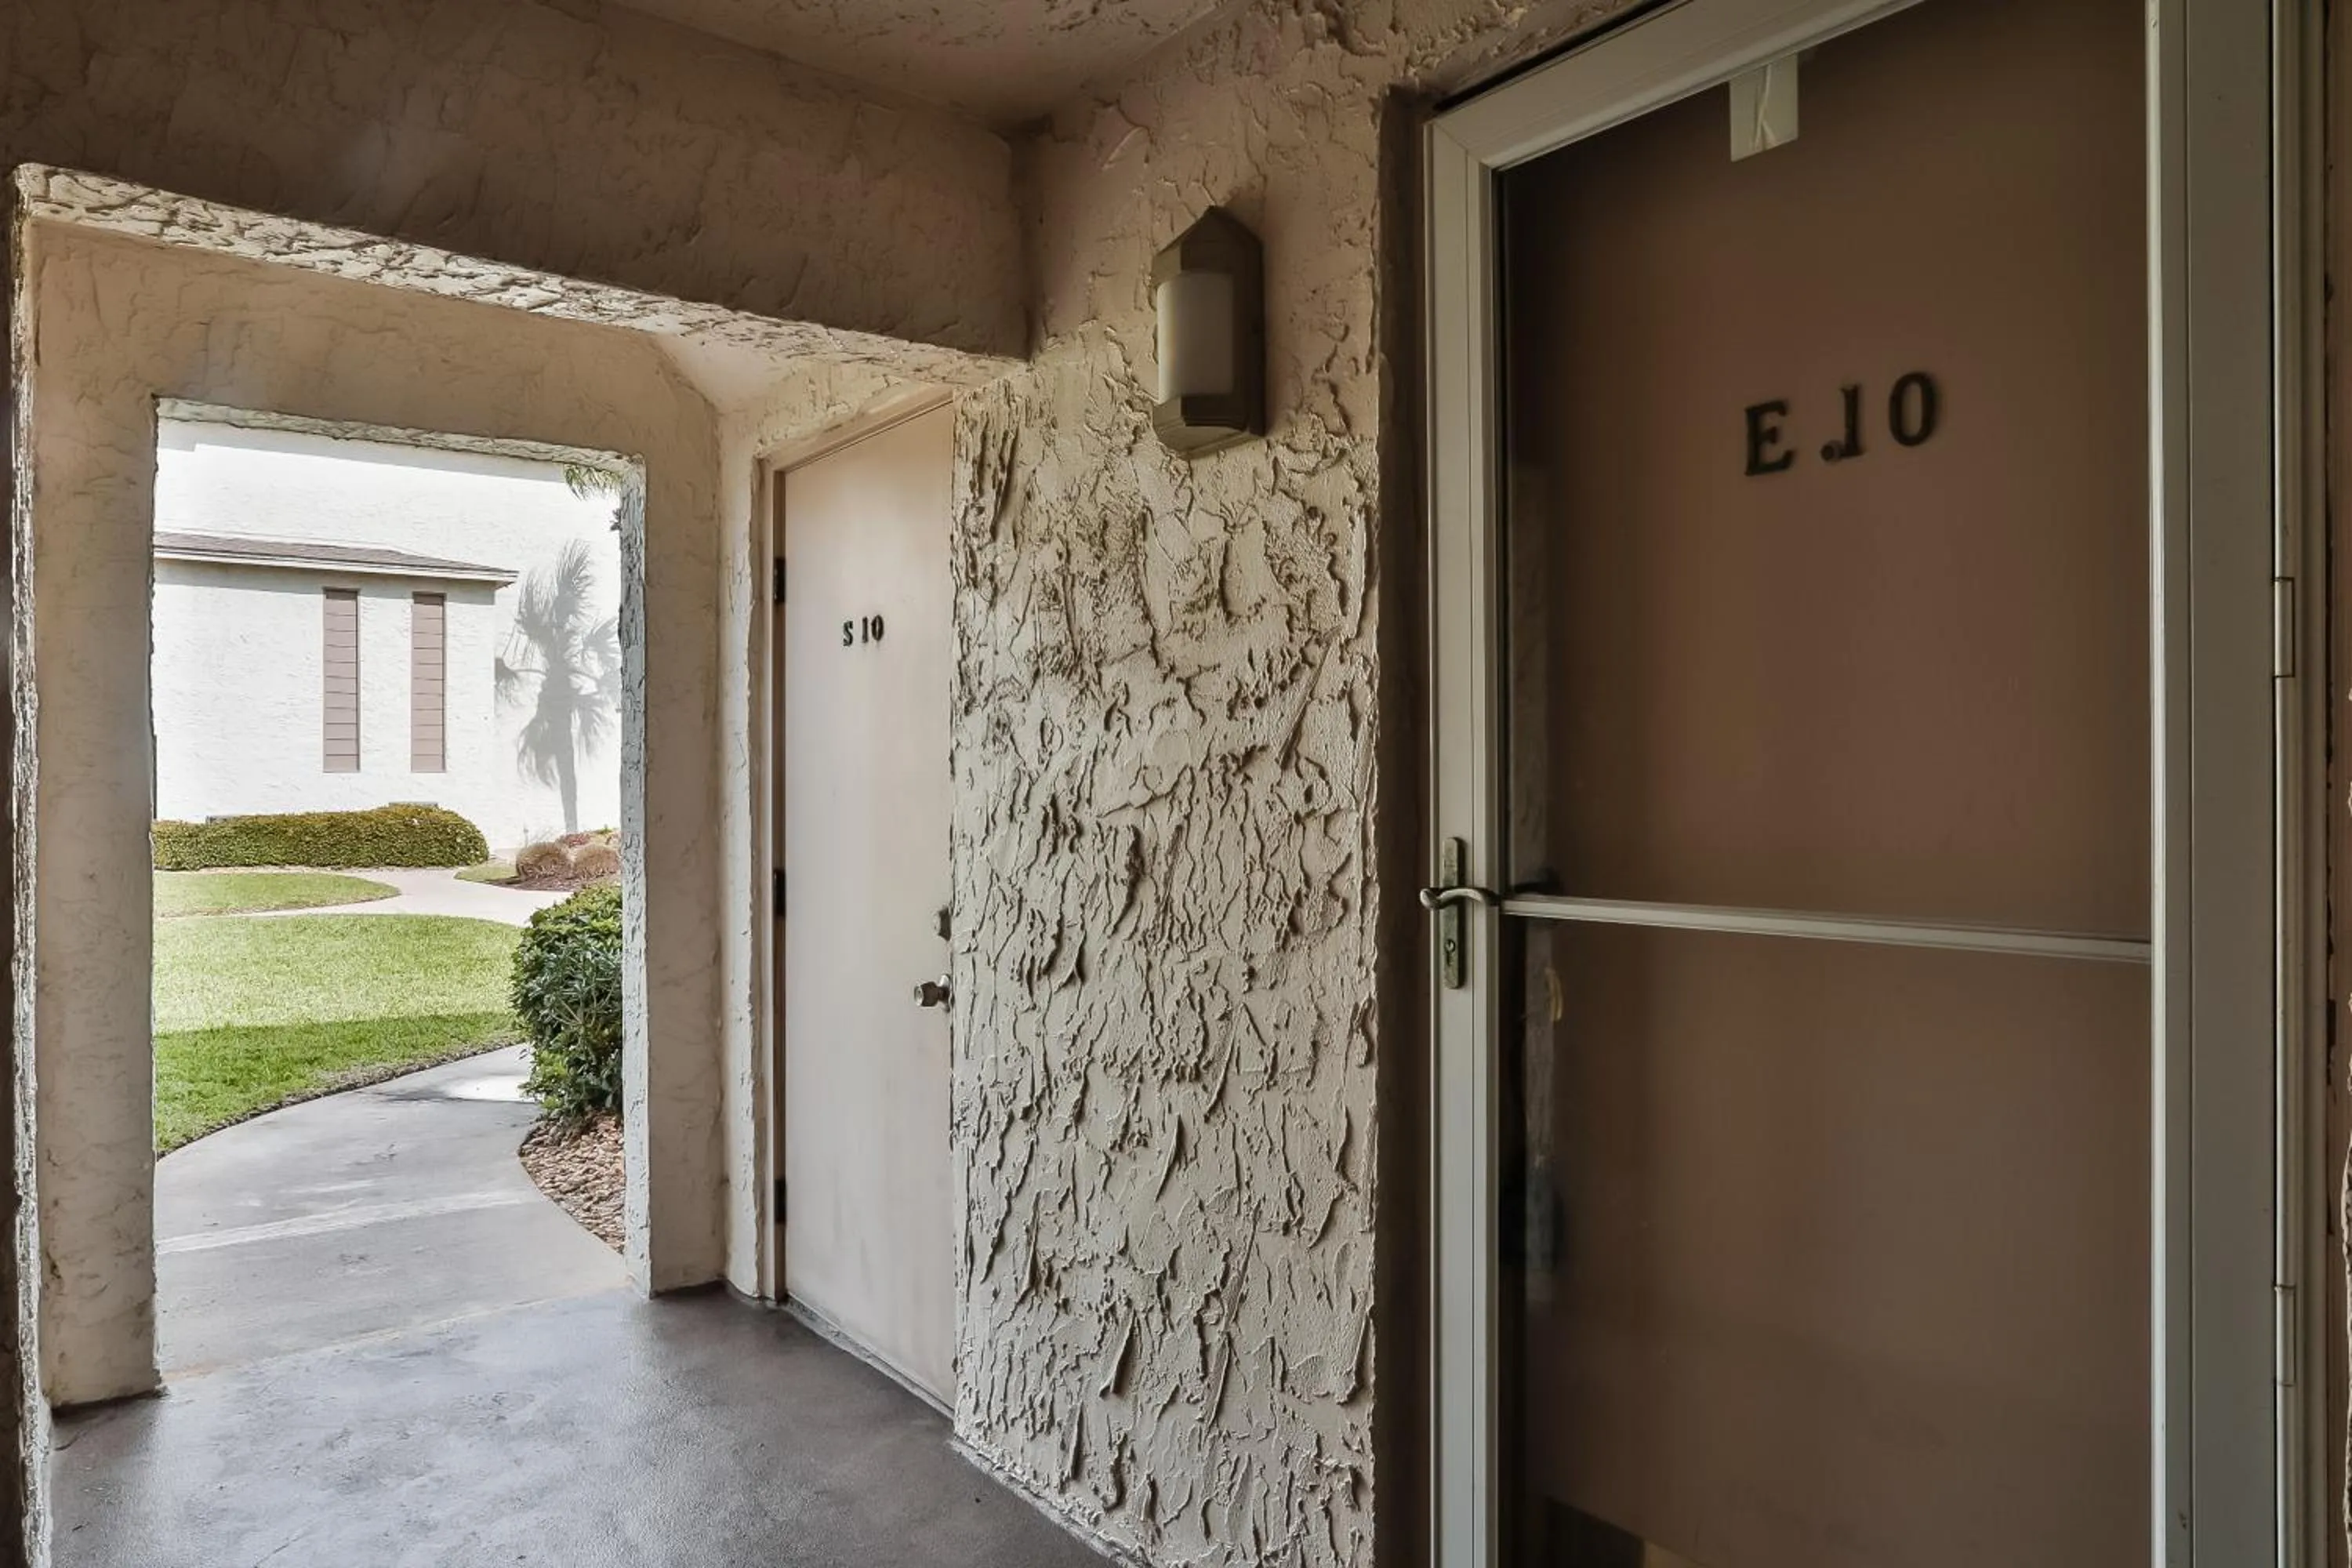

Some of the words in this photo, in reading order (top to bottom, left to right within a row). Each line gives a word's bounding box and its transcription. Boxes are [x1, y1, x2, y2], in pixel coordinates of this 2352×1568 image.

[1743, 397, 1796, 477] E
[843, 620, 854, 647] S
[862, 614, 884, 644] 10
